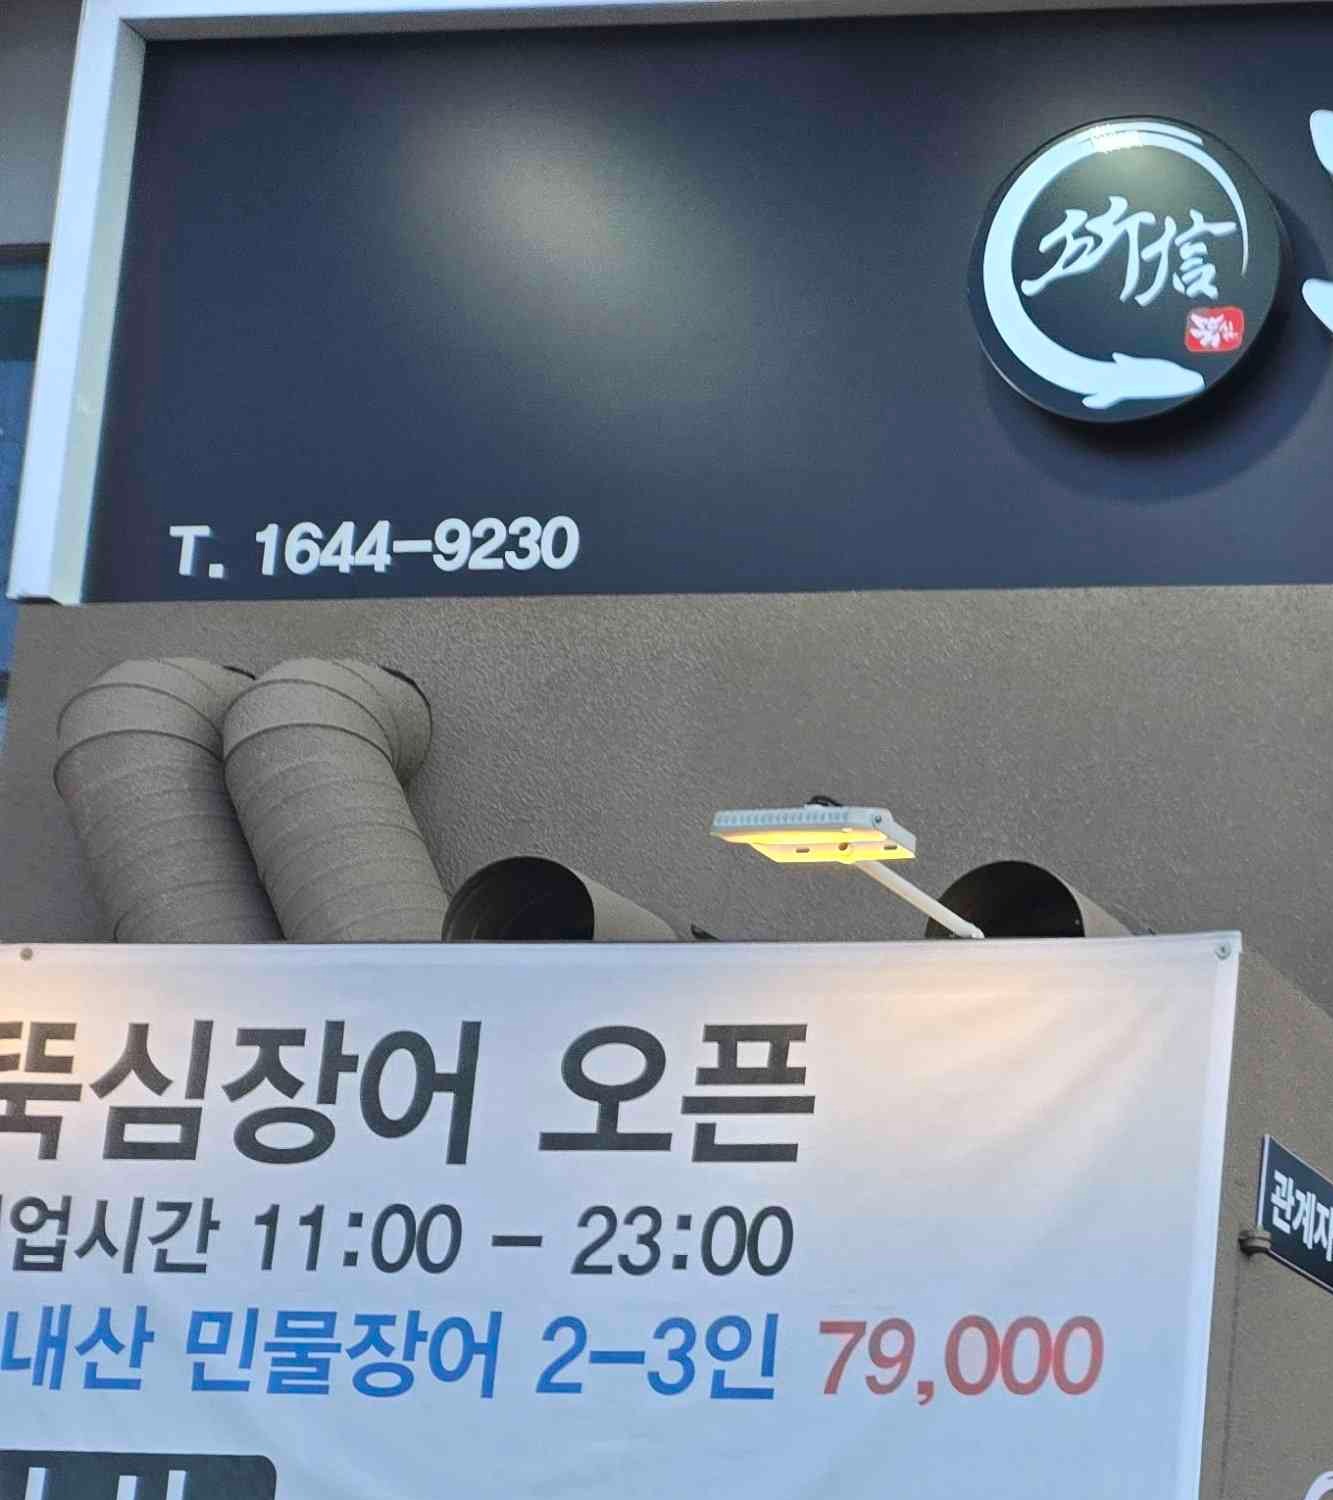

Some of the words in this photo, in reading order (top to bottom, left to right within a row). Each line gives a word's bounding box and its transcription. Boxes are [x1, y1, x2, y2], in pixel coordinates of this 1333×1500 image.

[169, 525, 225, 579] T.
[256, 515, 581, 576] 1644-9230
[0, 1020, 481, 1164] 뚝심장어
[539, 1023, 816, 1163] 오픈
[0, 1195, 220, 1274] 업시간
[254, 1203, 463, 1273] 11:00
[570, 1205, 795, 1277] 23:00
[2, 1304, 154, 1391] 내산
[185, 1306, 502, 1398] 민물장어
[535, 1313, 779, 1400] 2-3인
[819, 1315, 1104, 1406] 79,000
